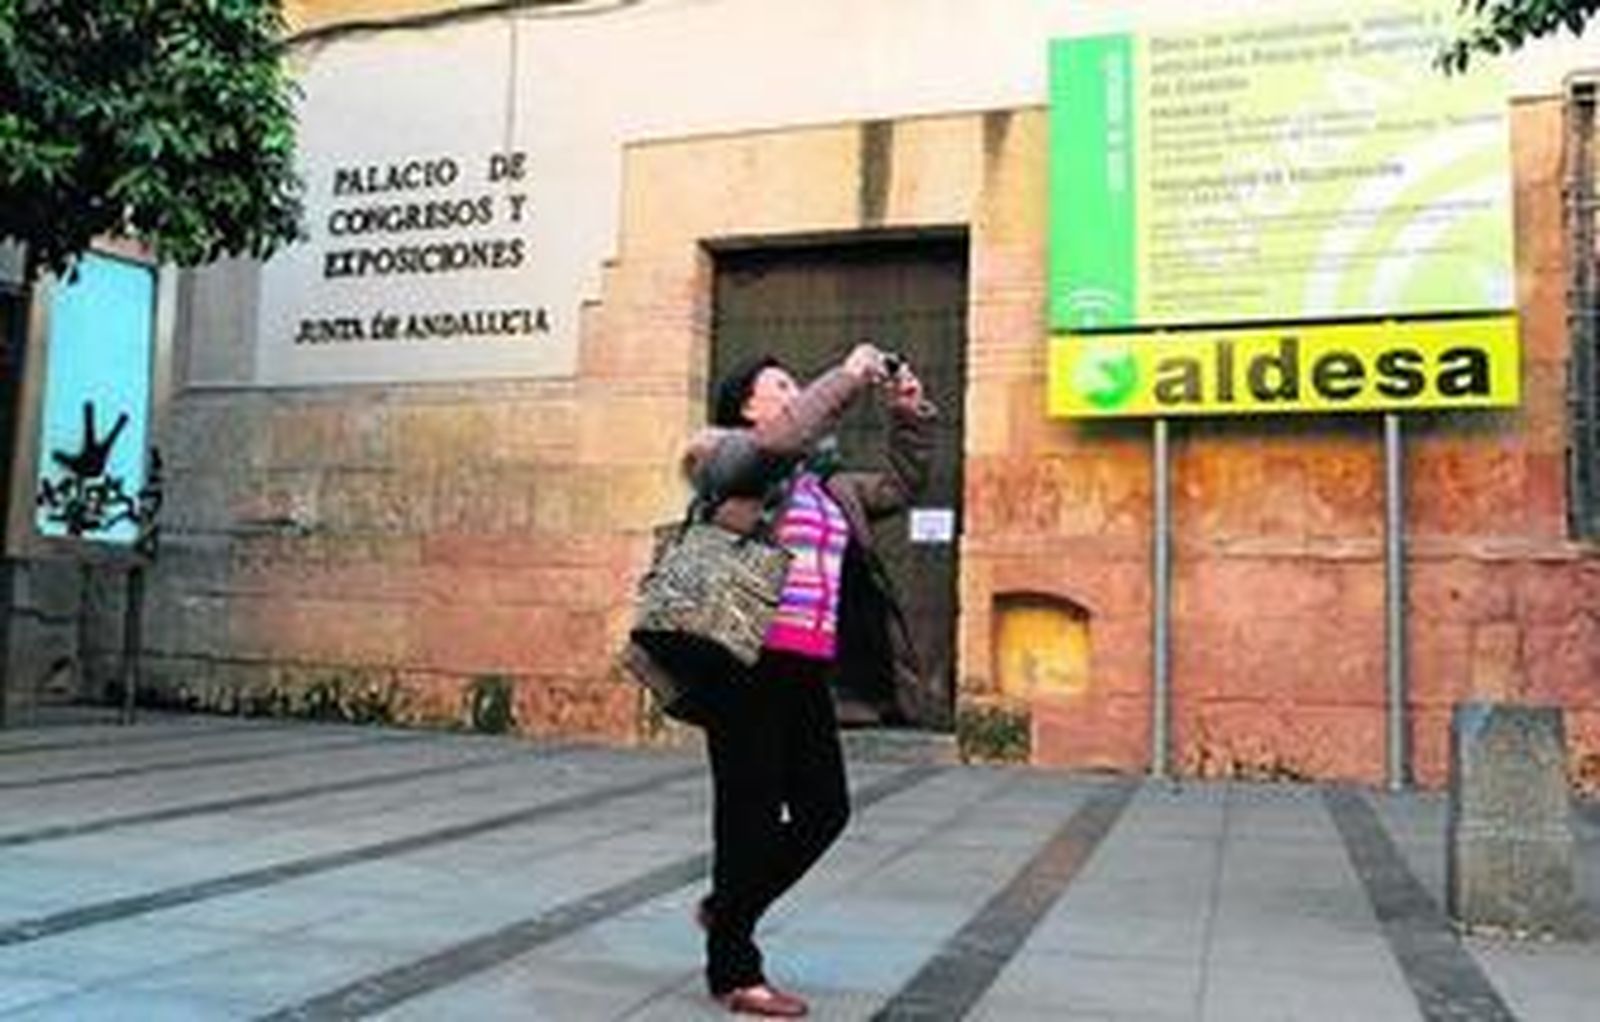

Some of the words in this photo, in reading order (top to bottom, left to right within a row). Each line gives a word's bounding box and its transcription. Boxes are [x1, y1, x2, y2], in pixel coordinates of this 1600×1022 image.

[333, 158, 458, 196] PALACIO
[489, 152, 526, 182] DE
[328, 196, 493, 236] CONGRESOS
[509, 194, 526, 221] Y
[323, 239, 525, 279] EXPOSICIONES
[295, 318, 364, 344] JUNTA
[371, 310, 399, 340] DE
[1153, 337, 1492, 405] aldesa
